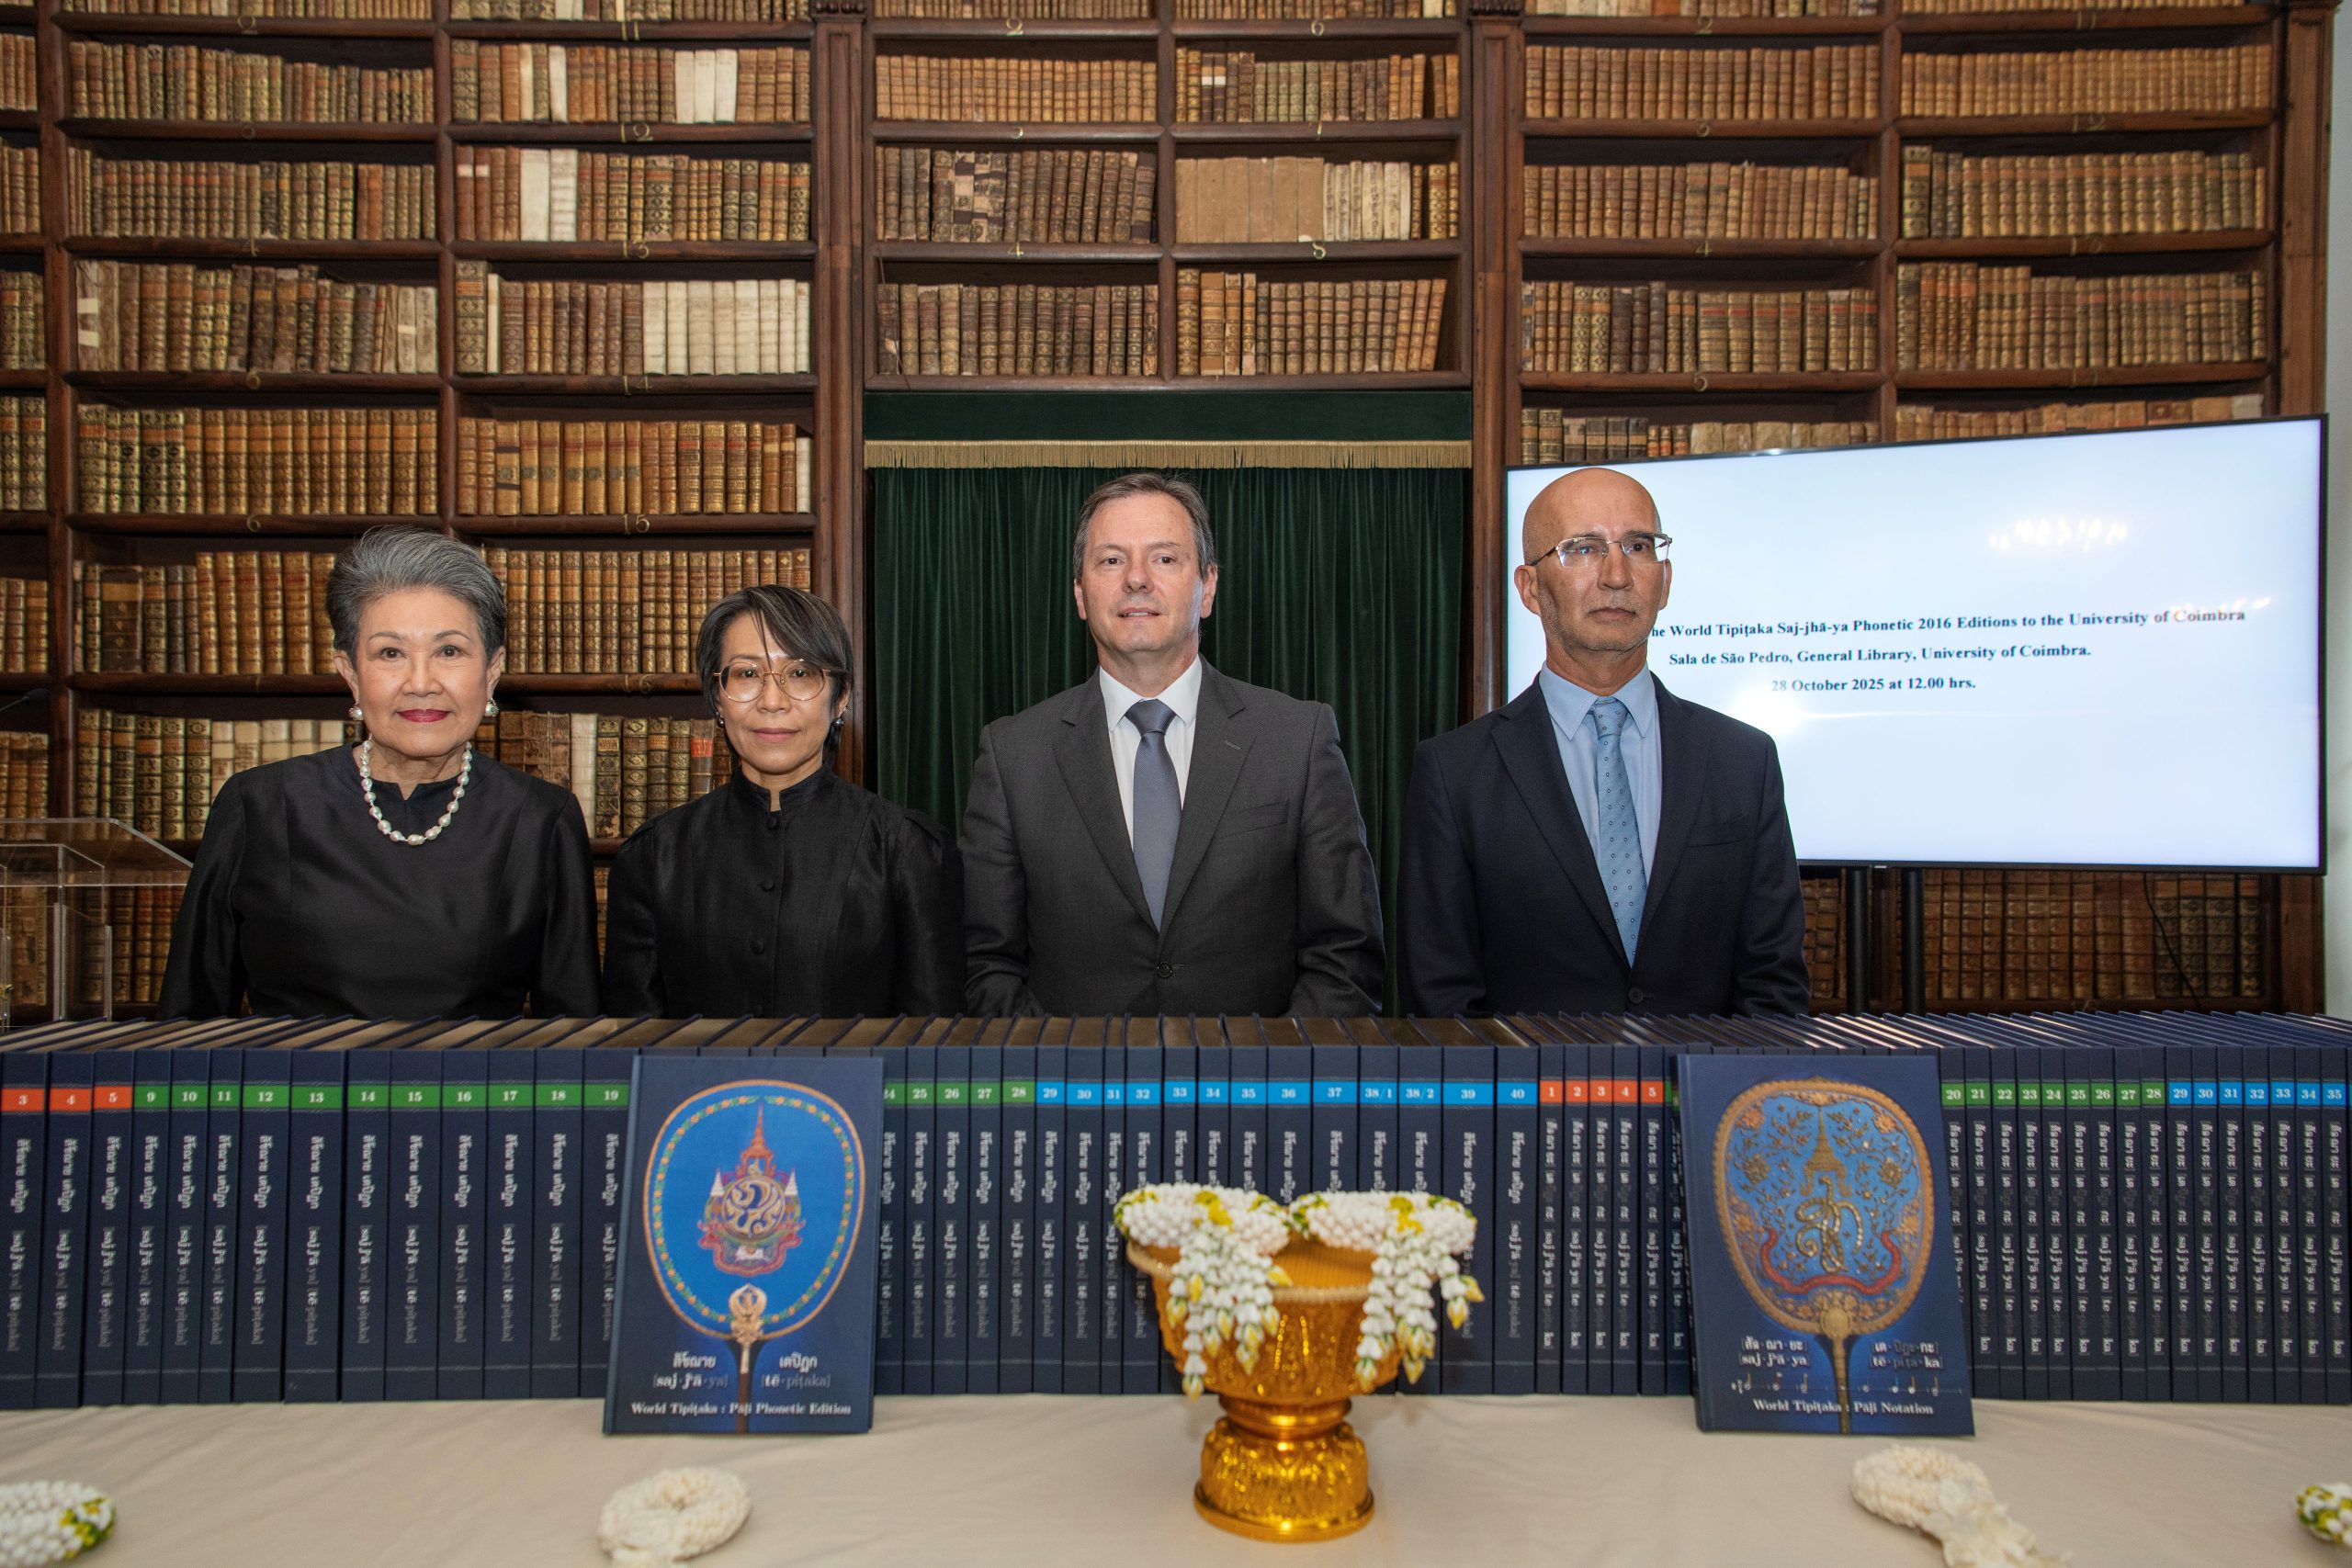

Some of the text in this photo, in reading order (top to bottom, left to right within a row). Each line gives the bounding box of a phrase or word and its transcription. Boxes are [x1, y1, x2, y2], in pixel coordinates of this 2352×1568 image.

[1006, 17, 1023, 37] 2
[1311, 18, 1325, 37] 6
[621, 123, 654, 143] 12
[1007, 241, 1024, 258] 4
[1695, 240, 1713, 258] 4
[246, 513, 262, 533] 6
[623, 513, 650, 536] 15
[1651, 625, 1666, 637] he
[1669, 624, 1712, 637] World
[1853, 618, 1914, 631] Phonetic
[1918, 617, 1951, 630] 2016
[1957, 615, 2018, 628] Editions
[2022, 616, 2037, 626] to
[2041, 614, 2064, 626] the
[2069, 611, 2149, 626] University
[2154, 610, 2171, 623] of
[2174, 609, 2245, 623] Coimbra
[1669, 645, 2091, 665] Sala de São Pedro, General Library, University of Coimbra.
[1771, 677, 1976, 692] 28 October 2025 at 12.00 hrs.
[108, 1091, 119, 1103] 5
[146, 1091, 156, 1102] 9
[183, 1091, 198, 1102] 10
[218, 1090, 231, 1102] 11
[258, 1091, 274, 1102] 12
[361, 1091, 376, 1102] 14
[408, 1091, 423, 1102] 15
[457, 1091, 472, 1102] 16
[503, 1089, 518, 1101] 17
[551, 1090, 567, 1101] 18
[605, 1089, 619, 1101] 19
[912, 1088, 928, 1100] 25
[944, 1088, 960, 1100] 26
[977, 1088, 992, 1100] 27
[1012, 1087, 1027, 1098] 28
[1043, 1088, 1058, 1099] 29
[1077, 1089, 1092, 1100] 30
[1106, 1089, 1120, 1100] 31
[1136, 1089, 1150, 1100] 32
[1172, 1087, 1188, 1098] 33
[1205, 1088, 1221, 1099] 34
[1241, 1088, 1256, 1099] 35
[1281, 1088, 1296, 1099] 36
[1327, 1087, 1342, 1098] 37
[1461, 1089, 1476, 1100] 39
[1510, 1089, 1525, 1100] 40
[1549, 1087, 1555, 1098] 1
[1573, 1086, 1582, 1098] 2
[1597, 1086, 1606, 1097] 3
[1622, 1087, 1630, 1097] 4
[1648, 1087, 1657, 1098] 5
[1946, 1089, 1962, 1100] 20
[1971, 1089, 1985, 1100] 21
[1997, 1089, 2013, 1100] 22
[2022, 1089, 2038, 1100] 23
[2045, 1089, 2062, 1100] 24
[2071, 1089, 2086, 1100] 25
[2095, 1089, 2111, 1100] 26
[2120, 1089, 2136, 1100] 27
[2145, 1088, 2162, 1100] 28
[2173, 1088, 2188, 1099] 29
[2198, 1089, 2214, 1099] 30
[2223, 1088, 2238, 1099] 31
[2249, 1089, 2265, 1100] 32
[2276, 1088, 2291, 1099] 33
[2301, 1089, 2316, 1100] 34
[2327, 1089, 2343, 1100] 35
[18, 1094, 28, 1106] 3
[66, 1094, 75, 1106] 4
[309, 1092, 324, 1103] 13
[631, 1402, 667, 1415] World
[755, 1402, 806, 1415] Phonetic
[808, 1402, 852, 1415] Edition
[1753, 1398, 1789, 1412] World
[1882, 1402, 1934, 1415] Notation
